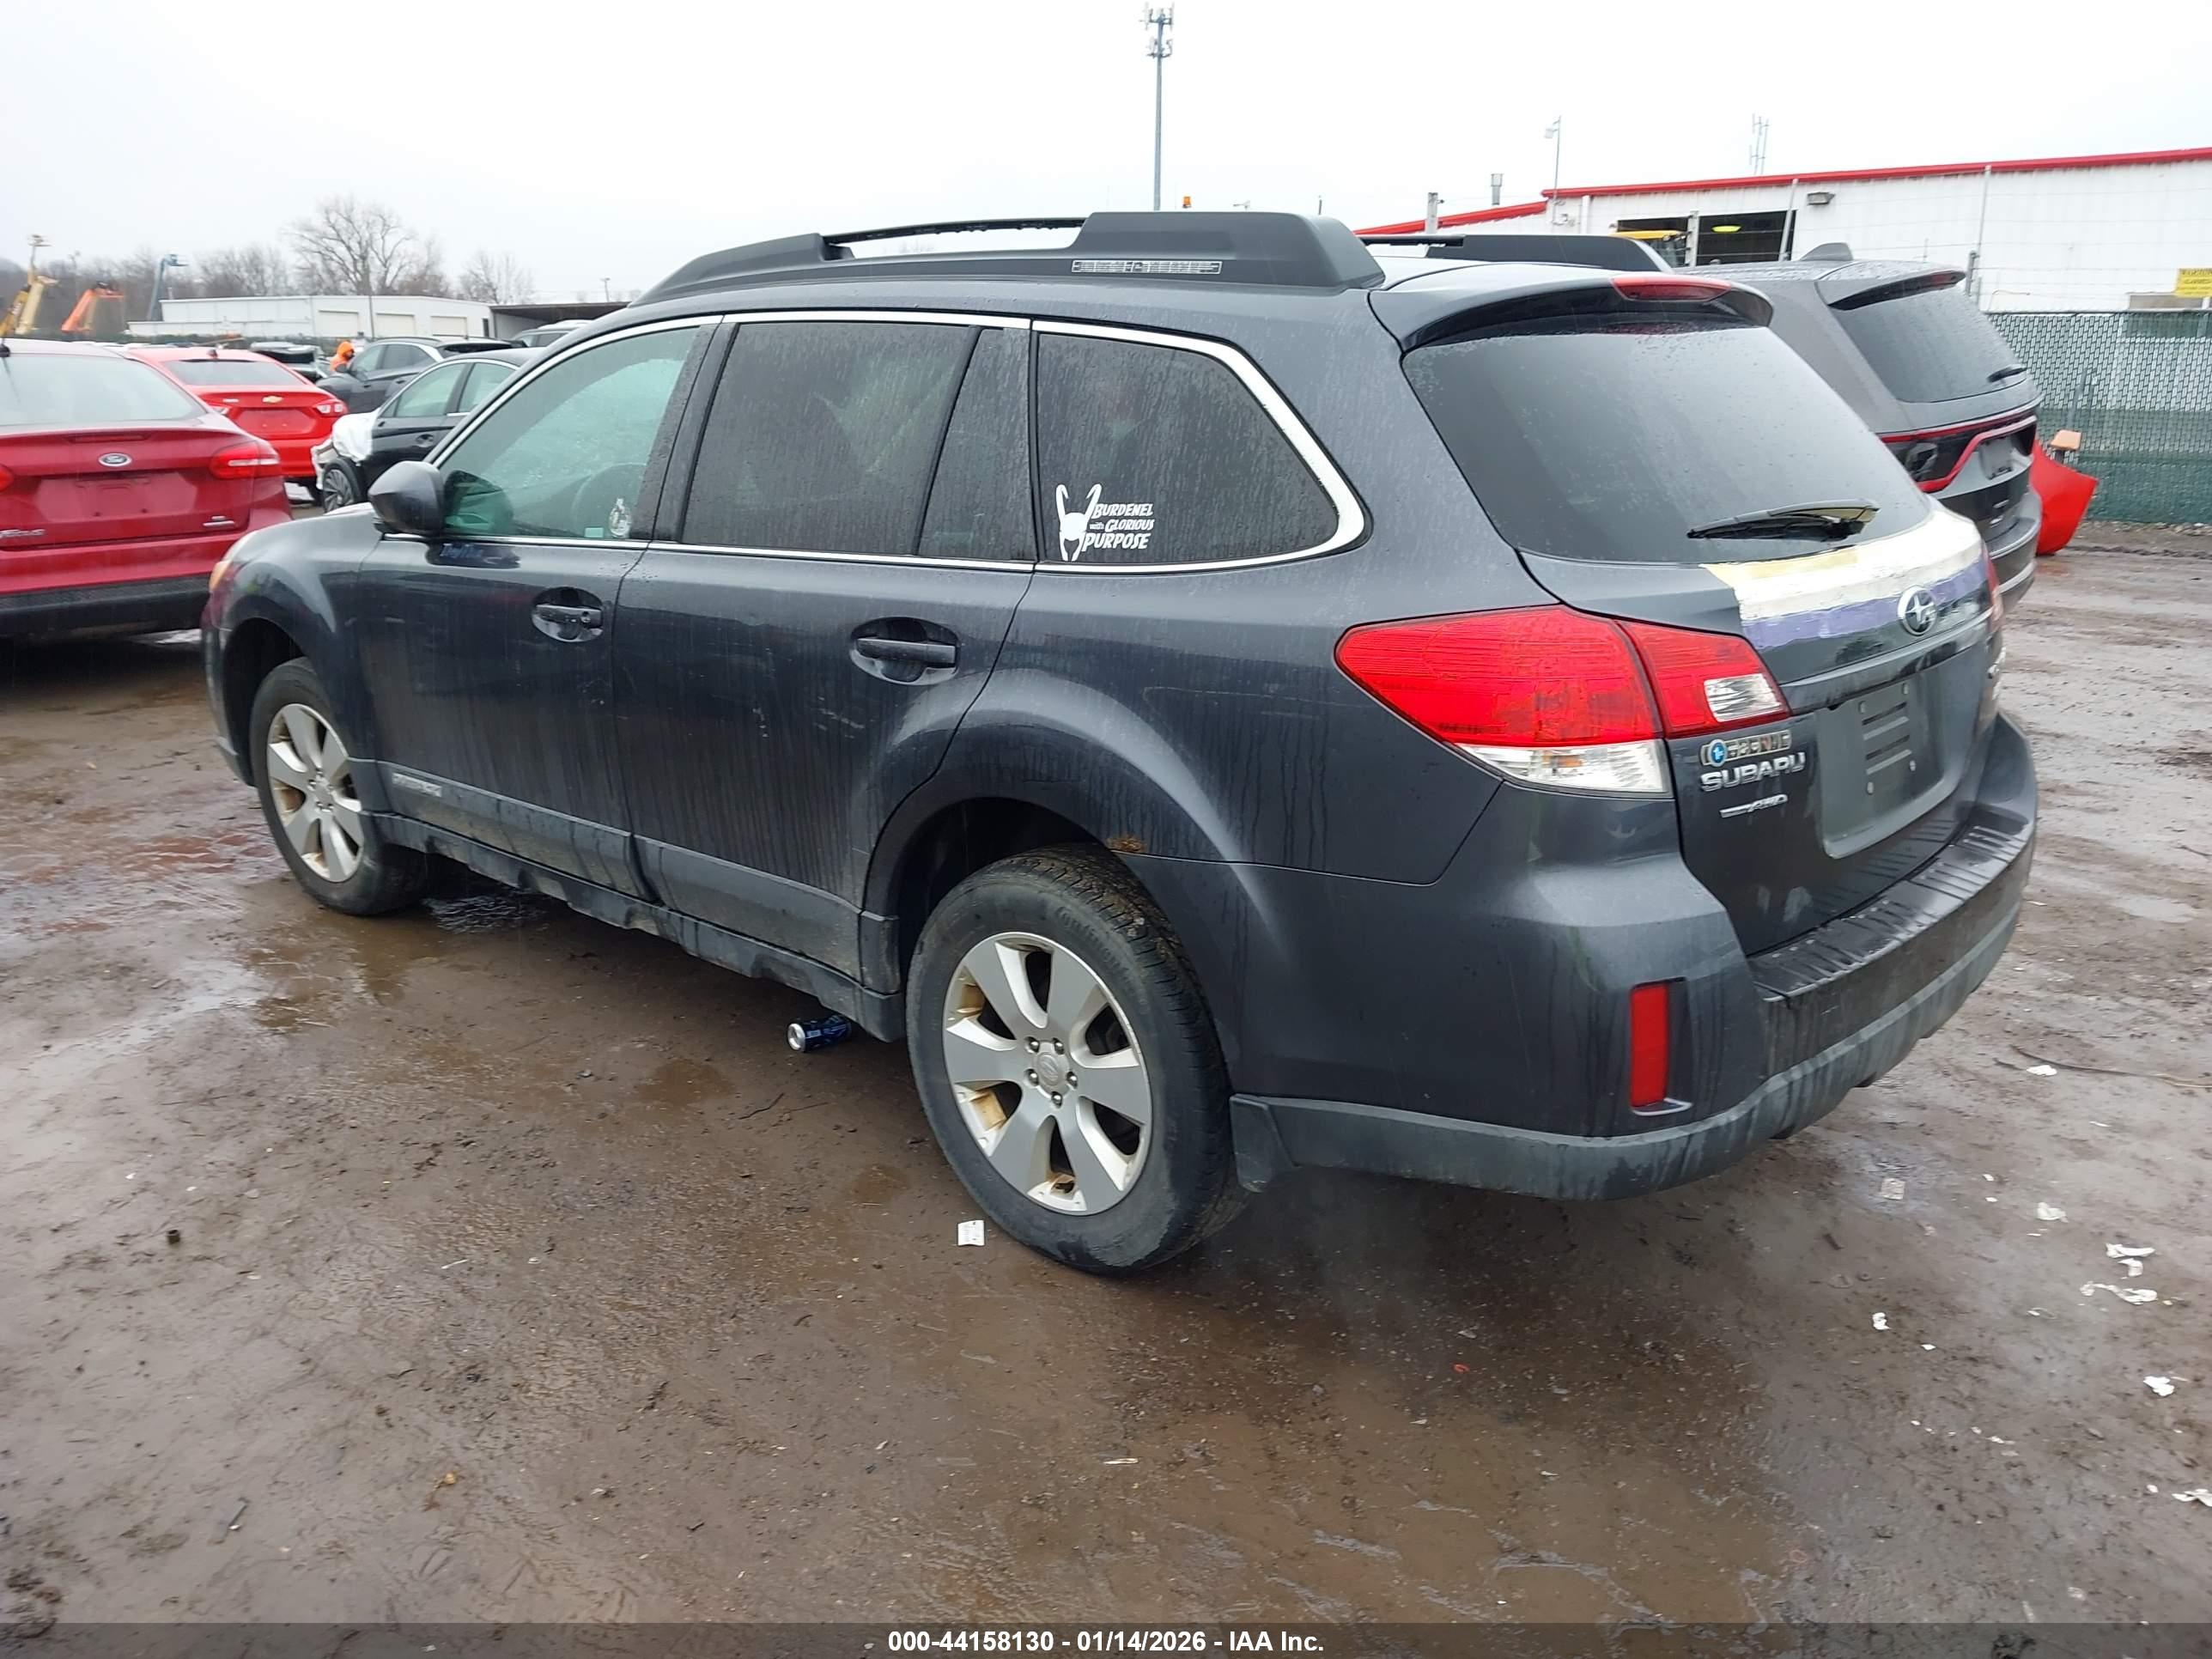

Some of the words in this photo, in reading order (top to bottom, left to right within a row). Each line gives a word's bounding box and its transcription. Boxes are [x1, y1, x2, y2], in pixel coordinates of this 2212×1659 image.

[1104, 519, 1155, 532] GLORIOUS
[1081, 532, 1152, 552] PURPOSE
[1699, 751, 1807, 793] SUBARU
